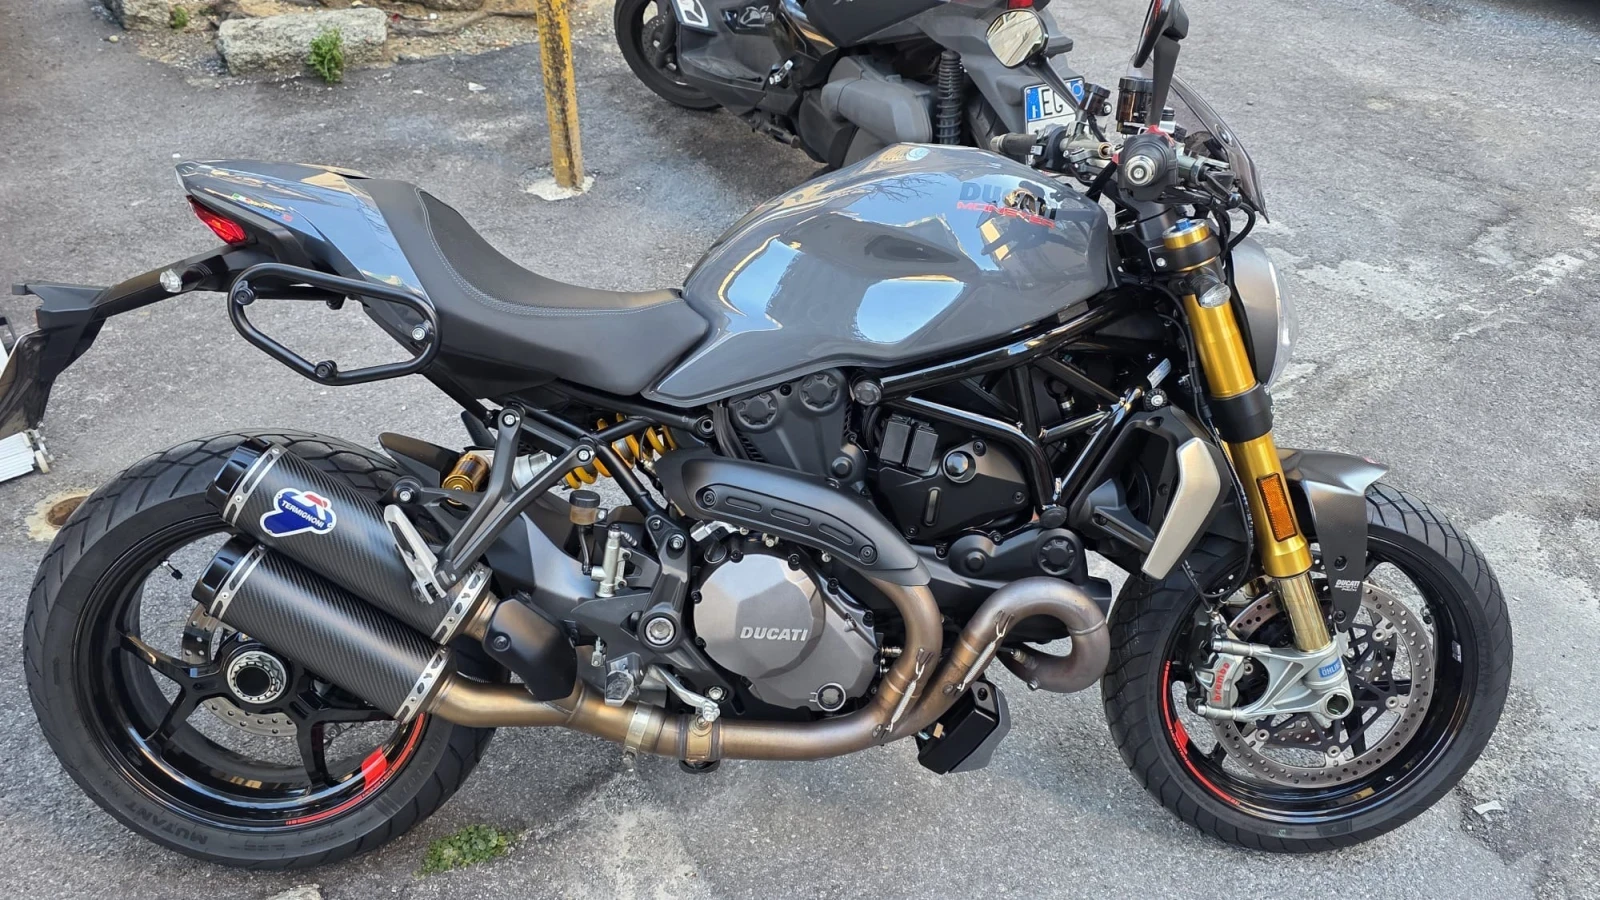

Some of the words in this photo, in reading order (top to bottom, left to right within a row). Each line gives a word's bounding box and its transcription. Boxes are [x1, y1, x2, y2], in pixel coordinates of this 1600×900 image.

[281, 500, 325, 528] TERMIGNONI
[740, 626, 809, 642] DUCATI
[1212, 662, 1230, 702] brembo
[124, 801, 209, 845] MUTANT
